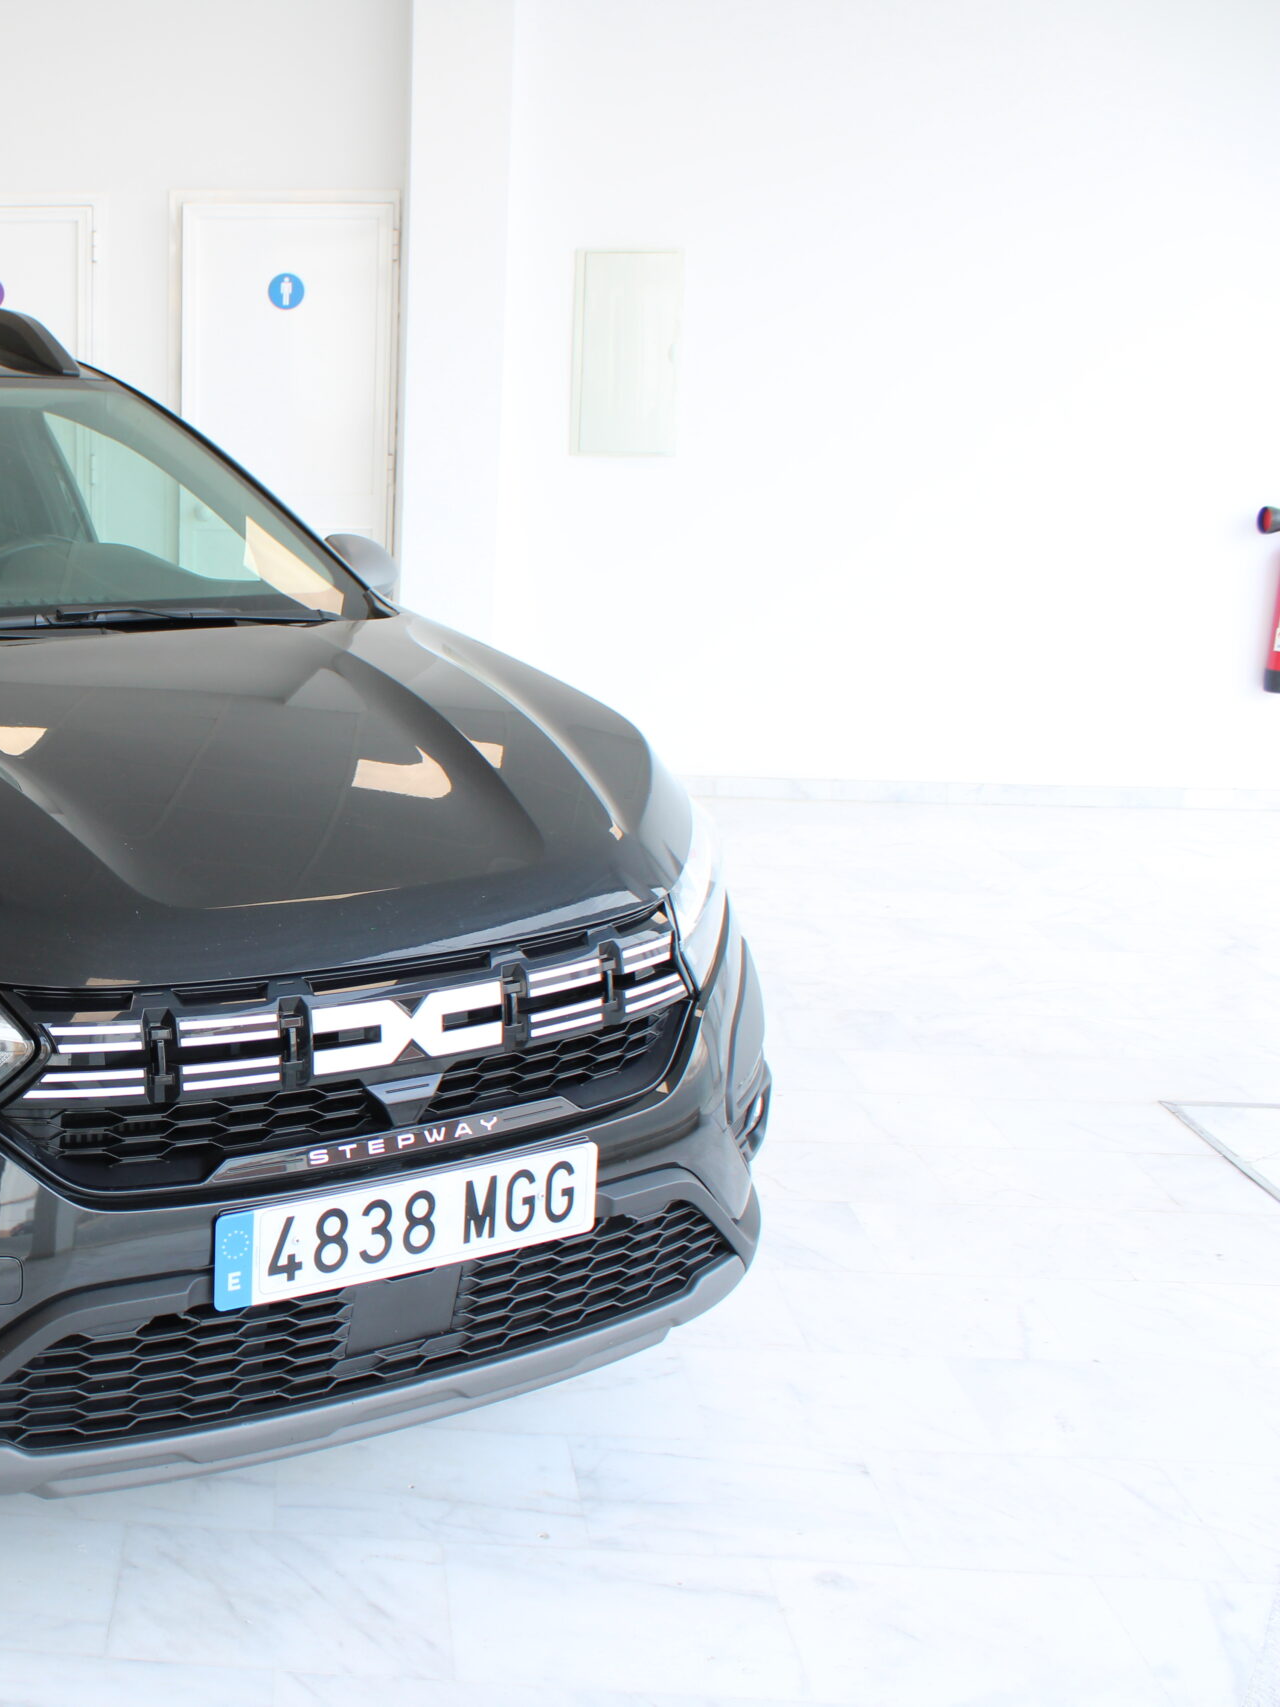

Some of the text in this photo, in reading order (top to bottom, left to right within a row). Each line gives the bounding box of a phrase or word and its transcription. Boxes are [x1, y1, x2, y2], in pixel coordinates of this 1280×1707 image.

[308, 1116, 498, 1166] STEPWAY
[267, 1160, 575, 1282] 4838 MGG
[227, 1271, 241, 1292] E
